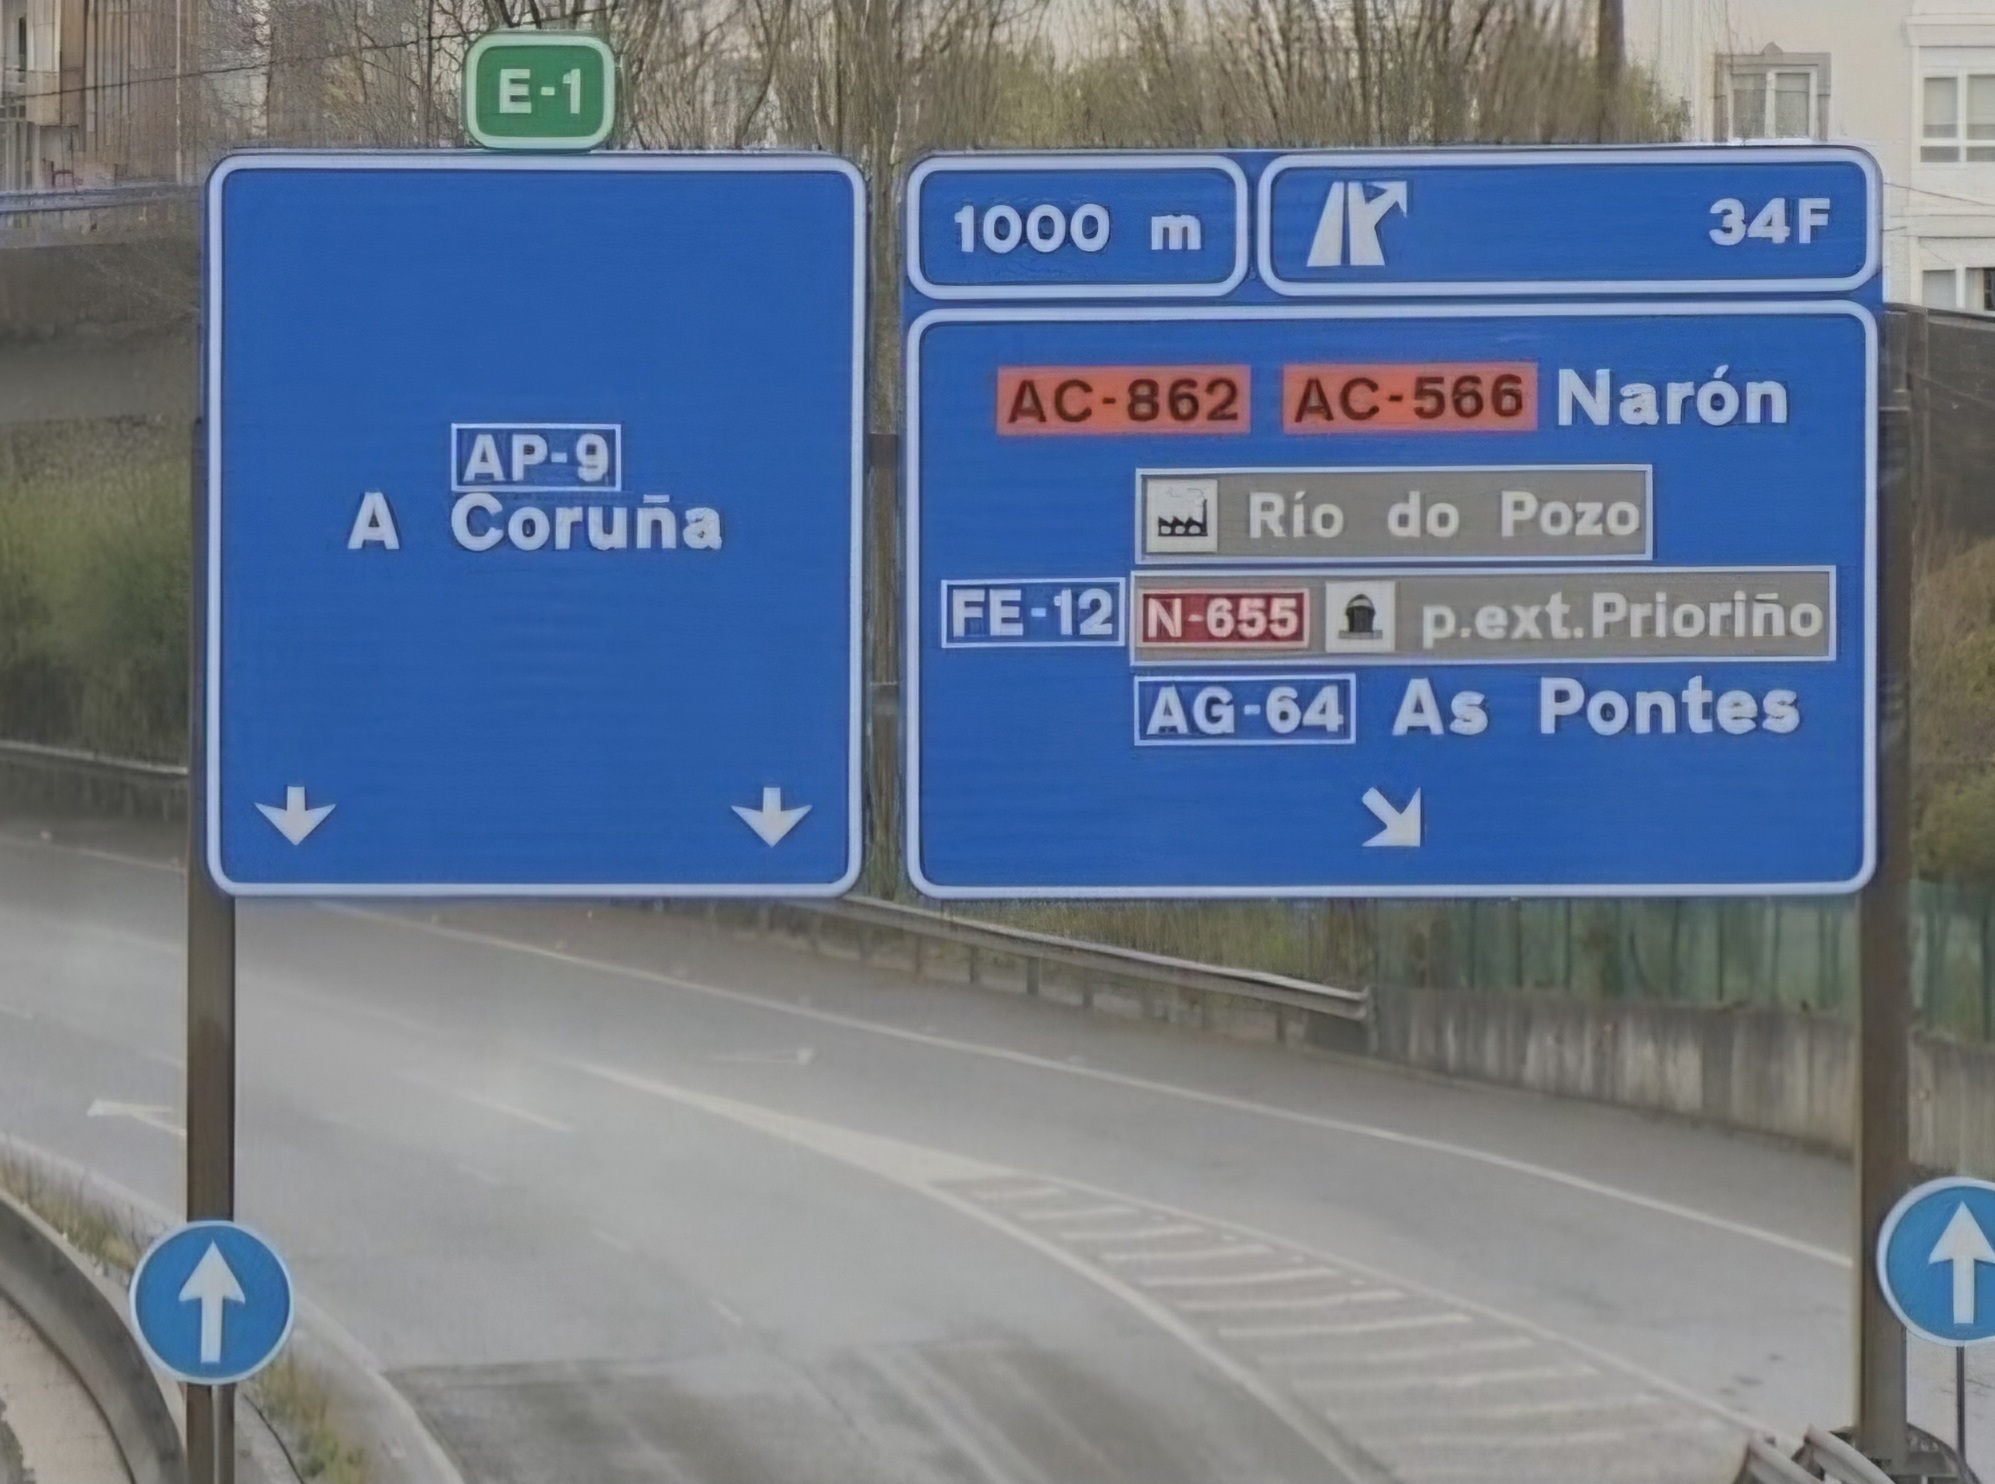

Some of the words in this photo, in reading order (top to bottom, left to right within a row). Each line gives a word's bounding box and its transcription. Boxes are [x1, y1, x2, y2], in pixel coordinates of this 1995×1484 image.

[499, 69, 581, 115] E-1
[953, 204, 1110, 253] 1000
[1150, 212, 1201, 251] m
[1708, 198, 1830, 246] 34F
[1008, 377, 1239, 423] AC-862
[1294, 373, 1524, 422] AC-566
[1558, 365, 1788, 426] Narón
[463, 433, 609, 483] AP-9
[347, 492, 399, 550] A
[451, 492, 722, 551] Coruña
[1248, 490, 1344, 539] Río
[1387, 490, 1460, 538] do
[1500, 490, 1641, 538] Pozo
[951, 588, 1114, 638] FE-12
[1145, 596, 1300, 639] N-655
[1146, 685, 1344, 736] AG-64
[1392, 677, 1488, 736] As
[1540, 674, 1800, 736] Pontes
